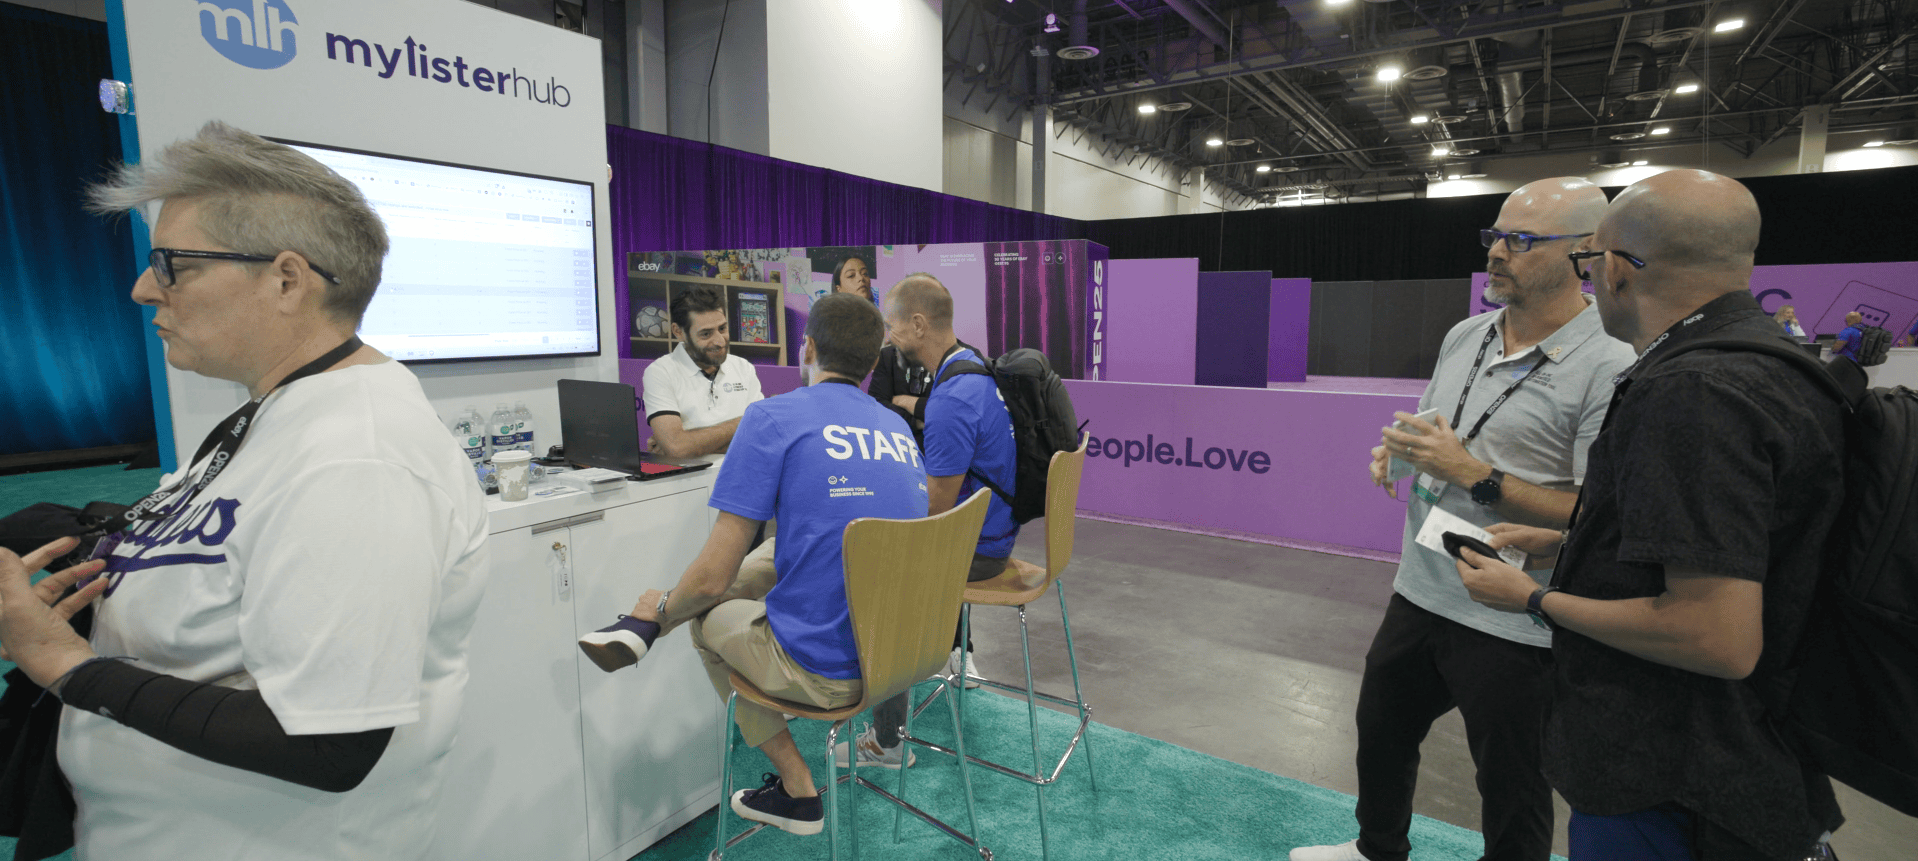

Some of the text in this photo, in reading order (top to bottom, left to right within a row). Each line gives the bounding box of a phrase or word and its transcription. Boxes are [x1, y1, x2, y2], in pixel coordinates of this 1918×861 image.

[326, 32, 571, 107] mylisterhub
[638, 261, 661, 272] ebay
[1092, 260, 1103, 381] PEN25
[231, 416, 247, 438] ebay
[822, 424, 919, 468] STAFF
